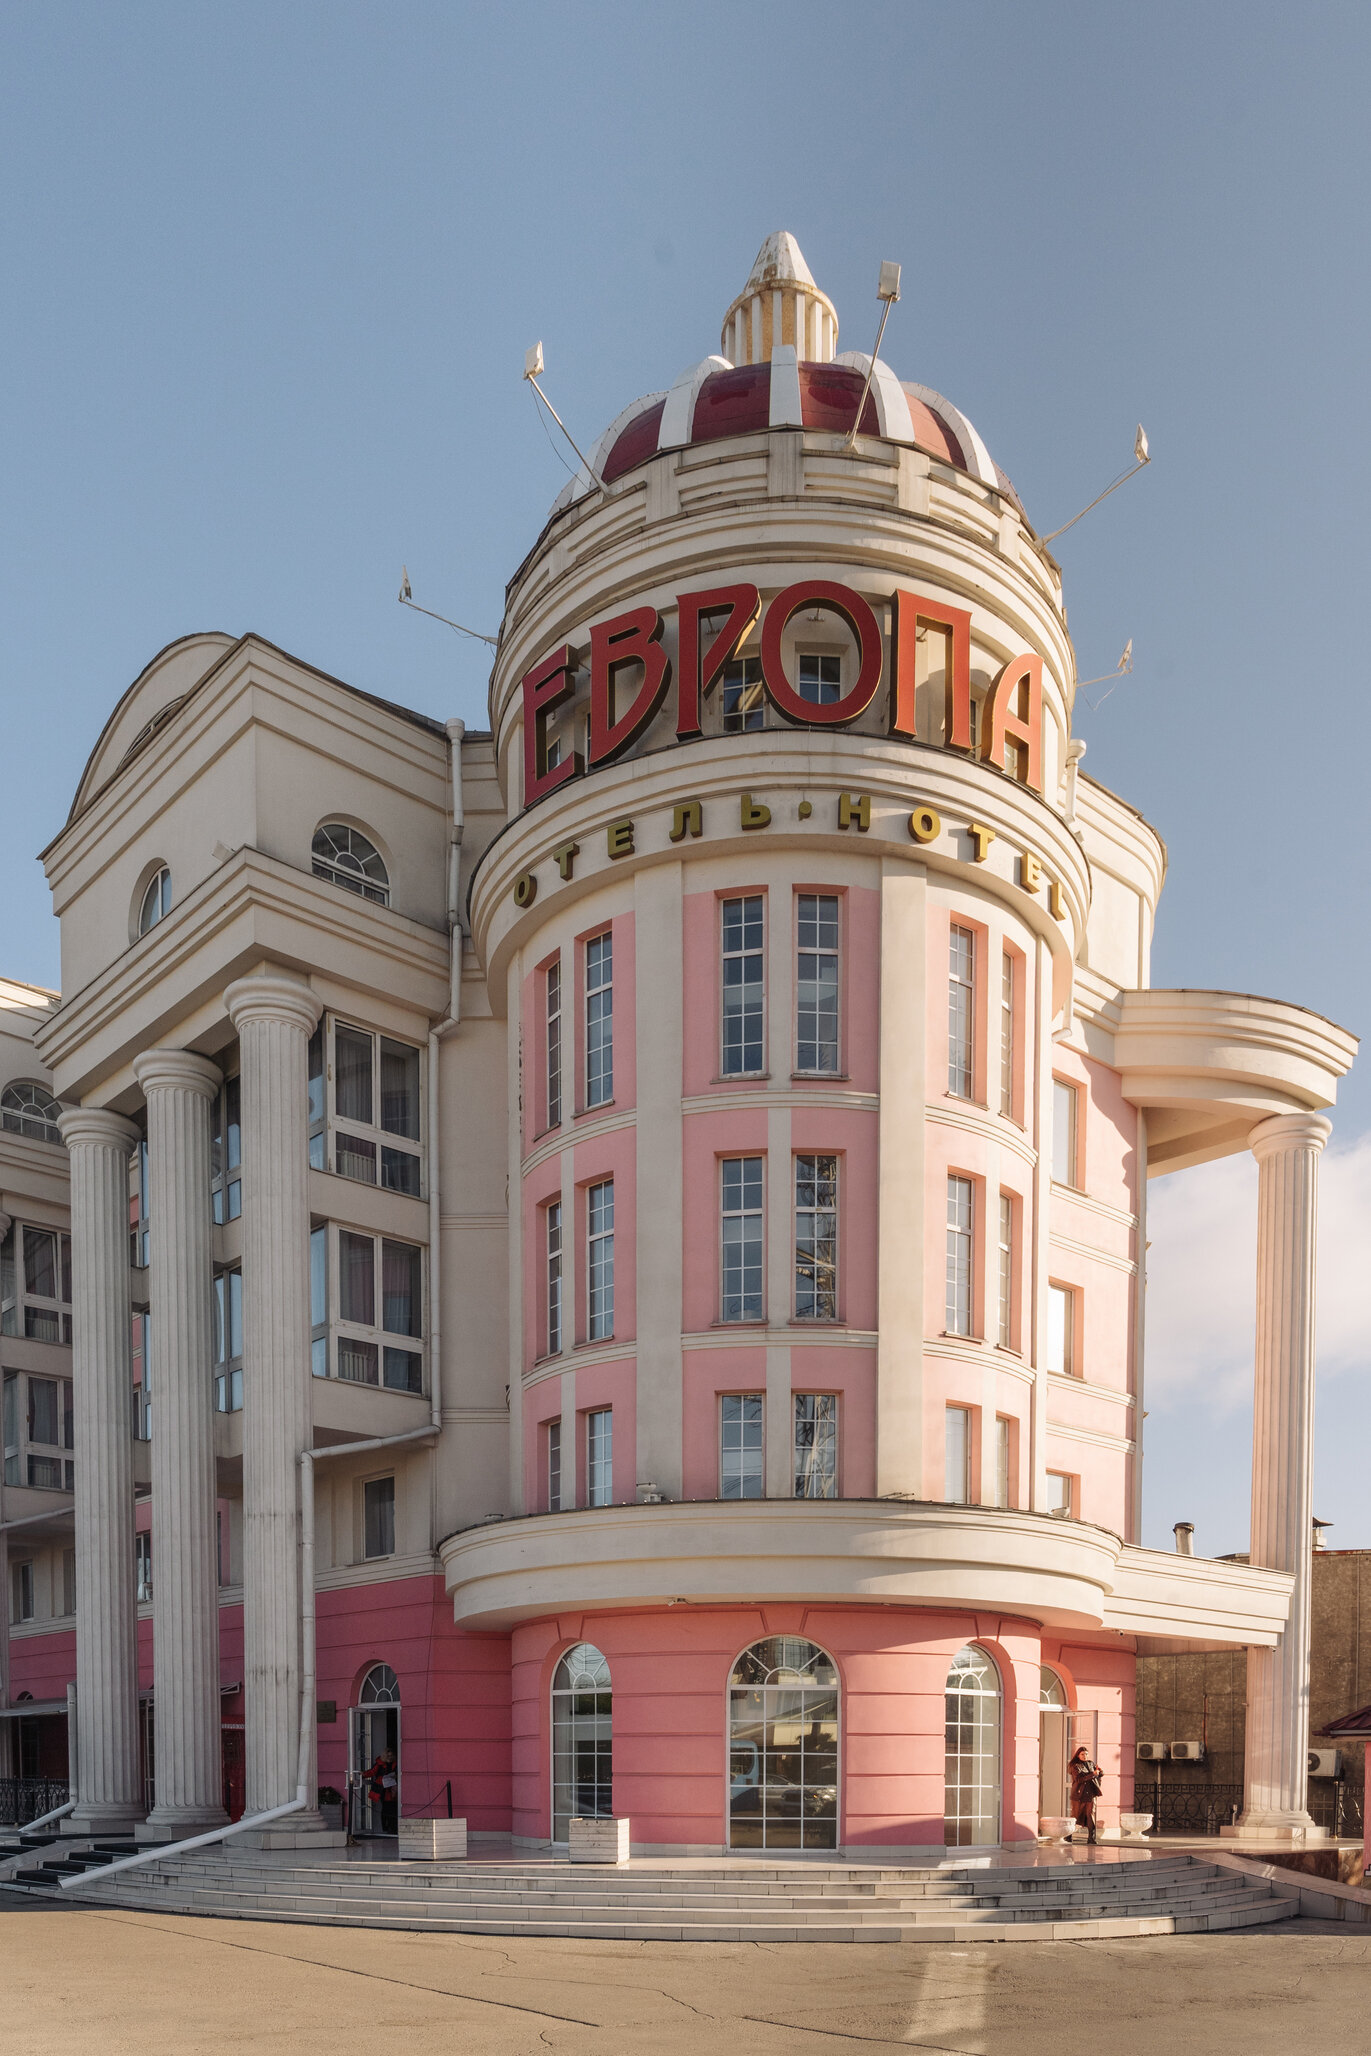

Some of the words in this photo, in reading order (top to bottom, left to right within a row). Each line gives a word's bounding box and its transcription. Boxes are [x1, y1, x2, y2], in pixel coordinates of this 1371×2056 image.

[522, 580, 1045, 808] ЕВРОПА
[513, 794, 772, 909] ОТЕЛЬ
[839, 793, 1066, 922] HOTEL
